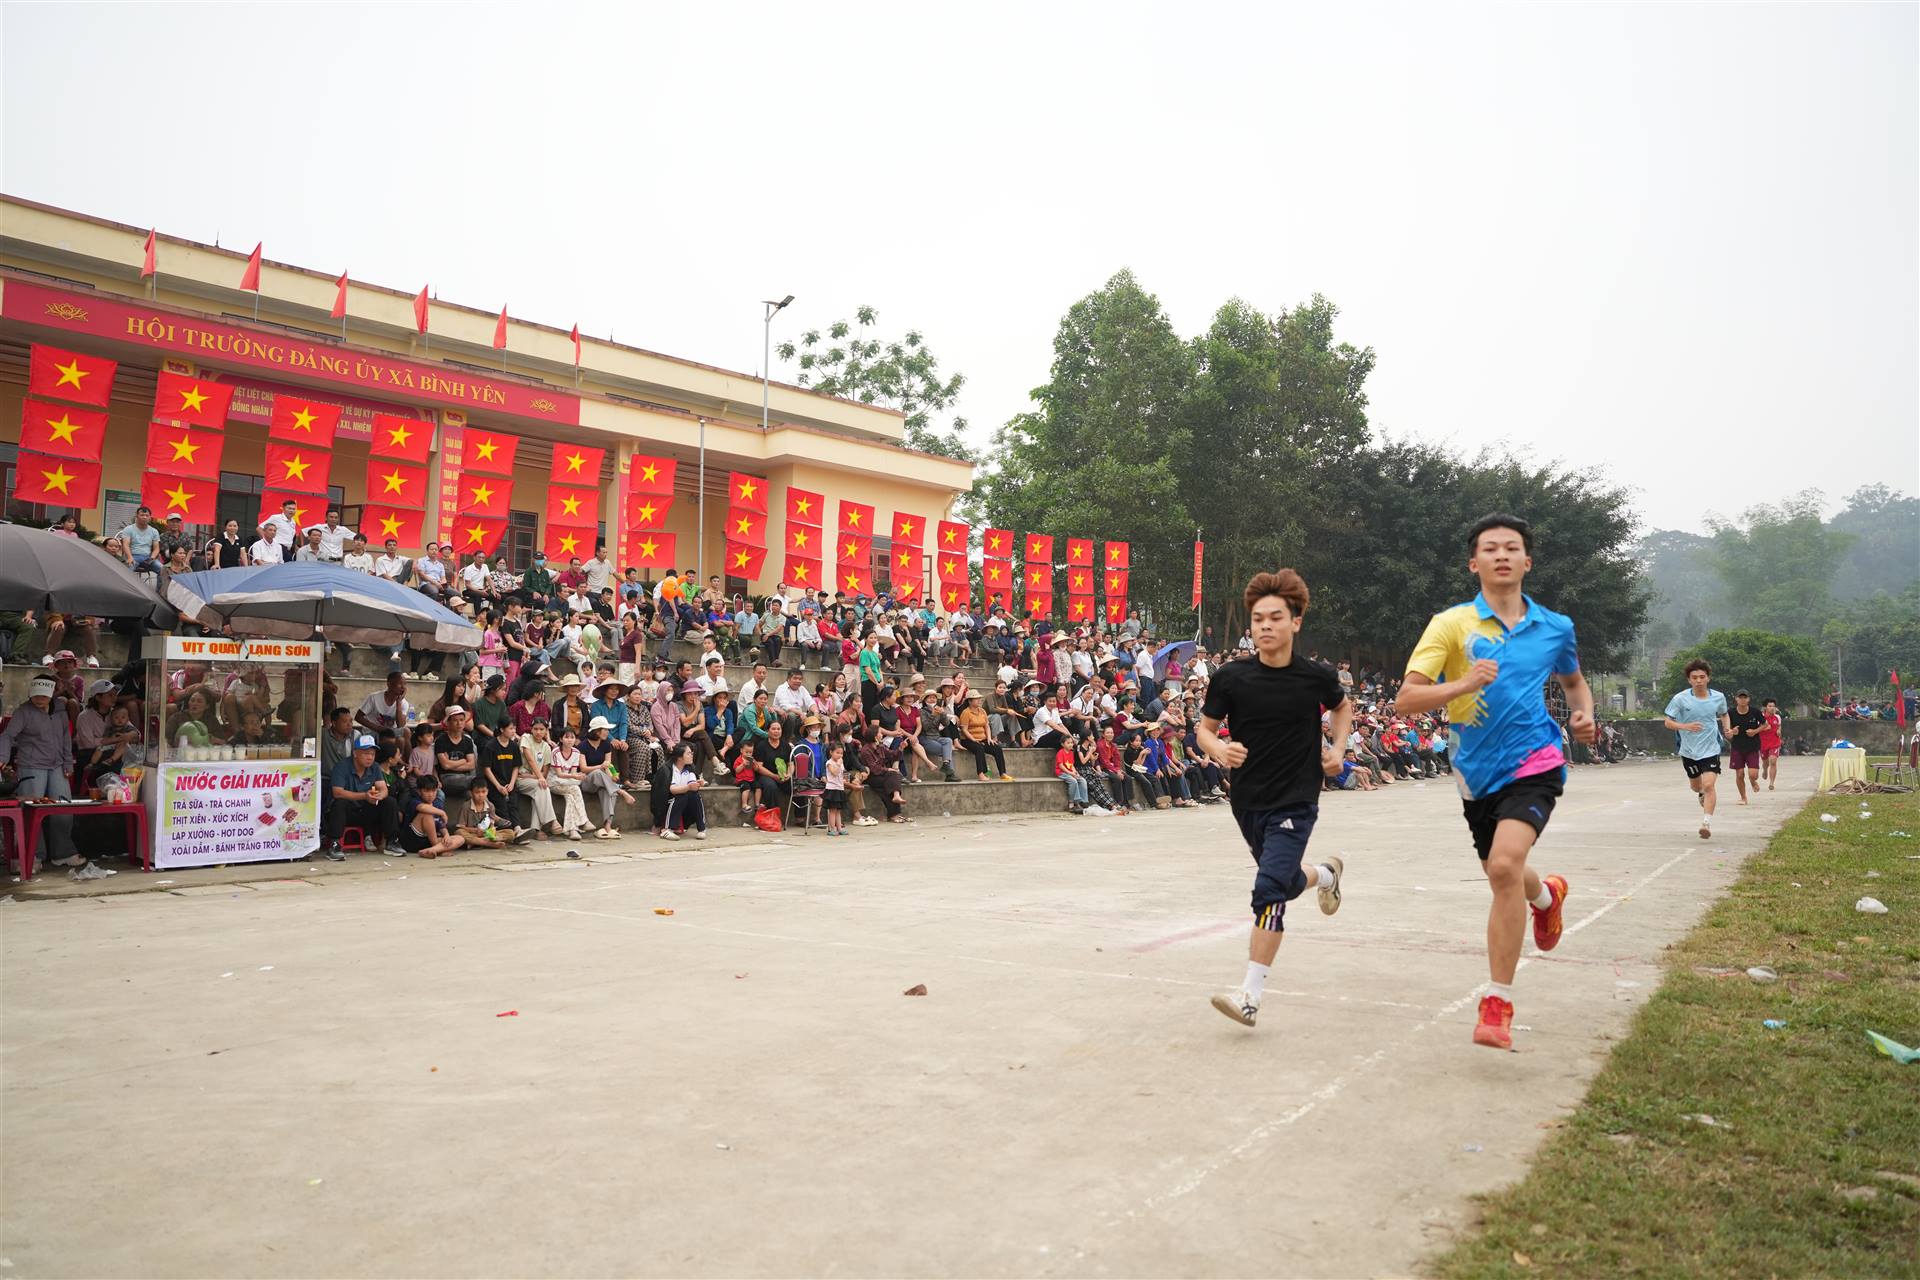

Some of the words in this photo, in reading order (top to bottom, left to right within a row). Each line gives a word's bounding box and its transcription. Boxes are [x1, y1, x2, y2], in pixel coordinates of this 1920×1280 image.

[126, 316, 176, 342] HỘI
[183, 327, 284, 363] TRƯỜNG
[290, 348, 349, 375] ĐẢNG
[355, 358, 384, 382] ỦY
[388, 369, 415, 388] XÃ
[420, 373, 465, 397] BÌNH
[470, 384, 507, 406] YÊN
[182, 641, 205, 656] VỊT
[209, 642, 241, 655] QUAY
[249, 644, 281, 657] LẠNG
[285, 643, 311, 657] SƠN
[176, 772, 218, 791] NƯỚC
[220, 769, 250, 790] GIẢI
[252, 769, 289, 789] KHÁT
[173, 799, 186, 810] TRÀ
[188, 798, 204, 809] SỮA
[209, 798, 223, 809] TRÀ
[224, 799, 251, 808] CHANH
[172, 816, 187, 826] THỊT
[189, 813, 207, 824] XIÊN
[212, 812, 229, 823] XÚC
[230, 811, 249, 823] XÍCH
[172, 831, 186, 843] LẠP
[221, 828, 236, 838] HOT
[237, 827, 254, 837] DOG
[172, 846, 191, 855] XOÀI
[215, 841, 236, 853] BÁNH
[263, 839, 281, 850] TRỘN
